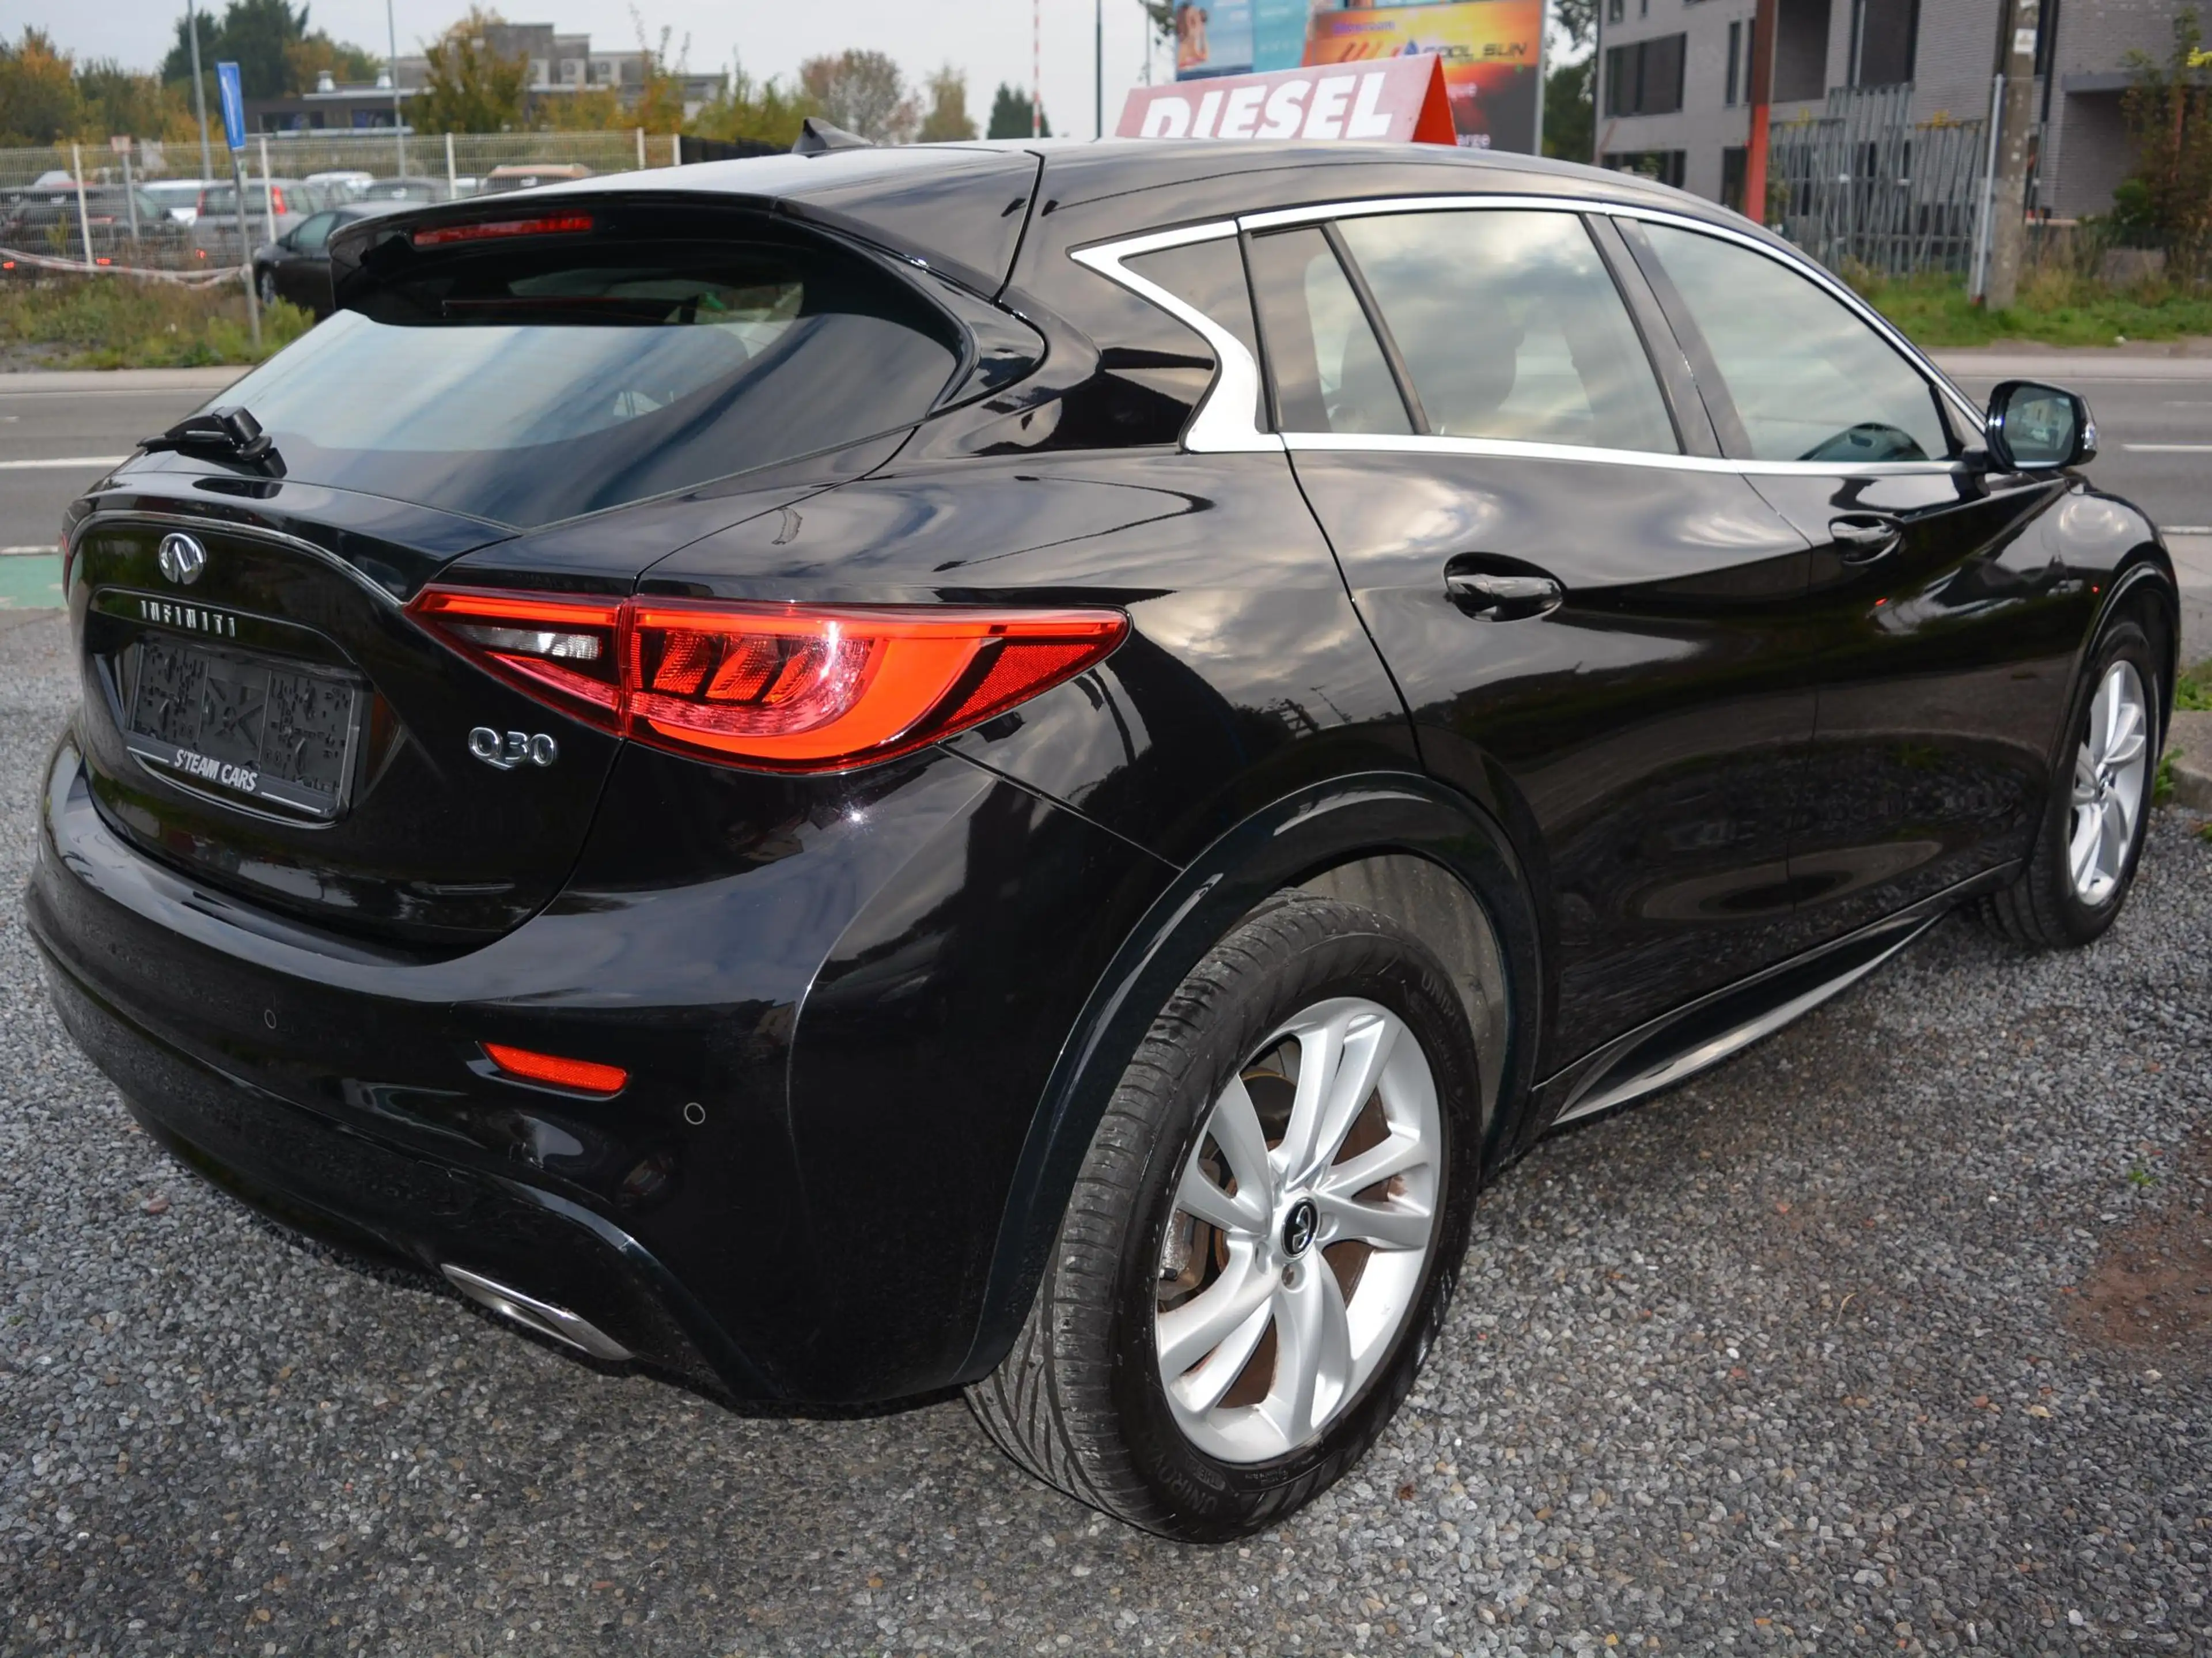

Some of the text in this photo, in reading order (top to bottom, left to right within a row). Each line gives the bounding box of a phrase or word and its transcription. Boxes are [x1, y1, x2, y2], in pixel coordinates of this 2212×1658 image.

[1483, 42, 1528, 57] SUN
[1139, 72, 1394, 139] DIESEL
[141, 600, 235, 638] INFINITI
[468, 726, 558, 770] Q30
[221, 764, 257, 792] CARS
